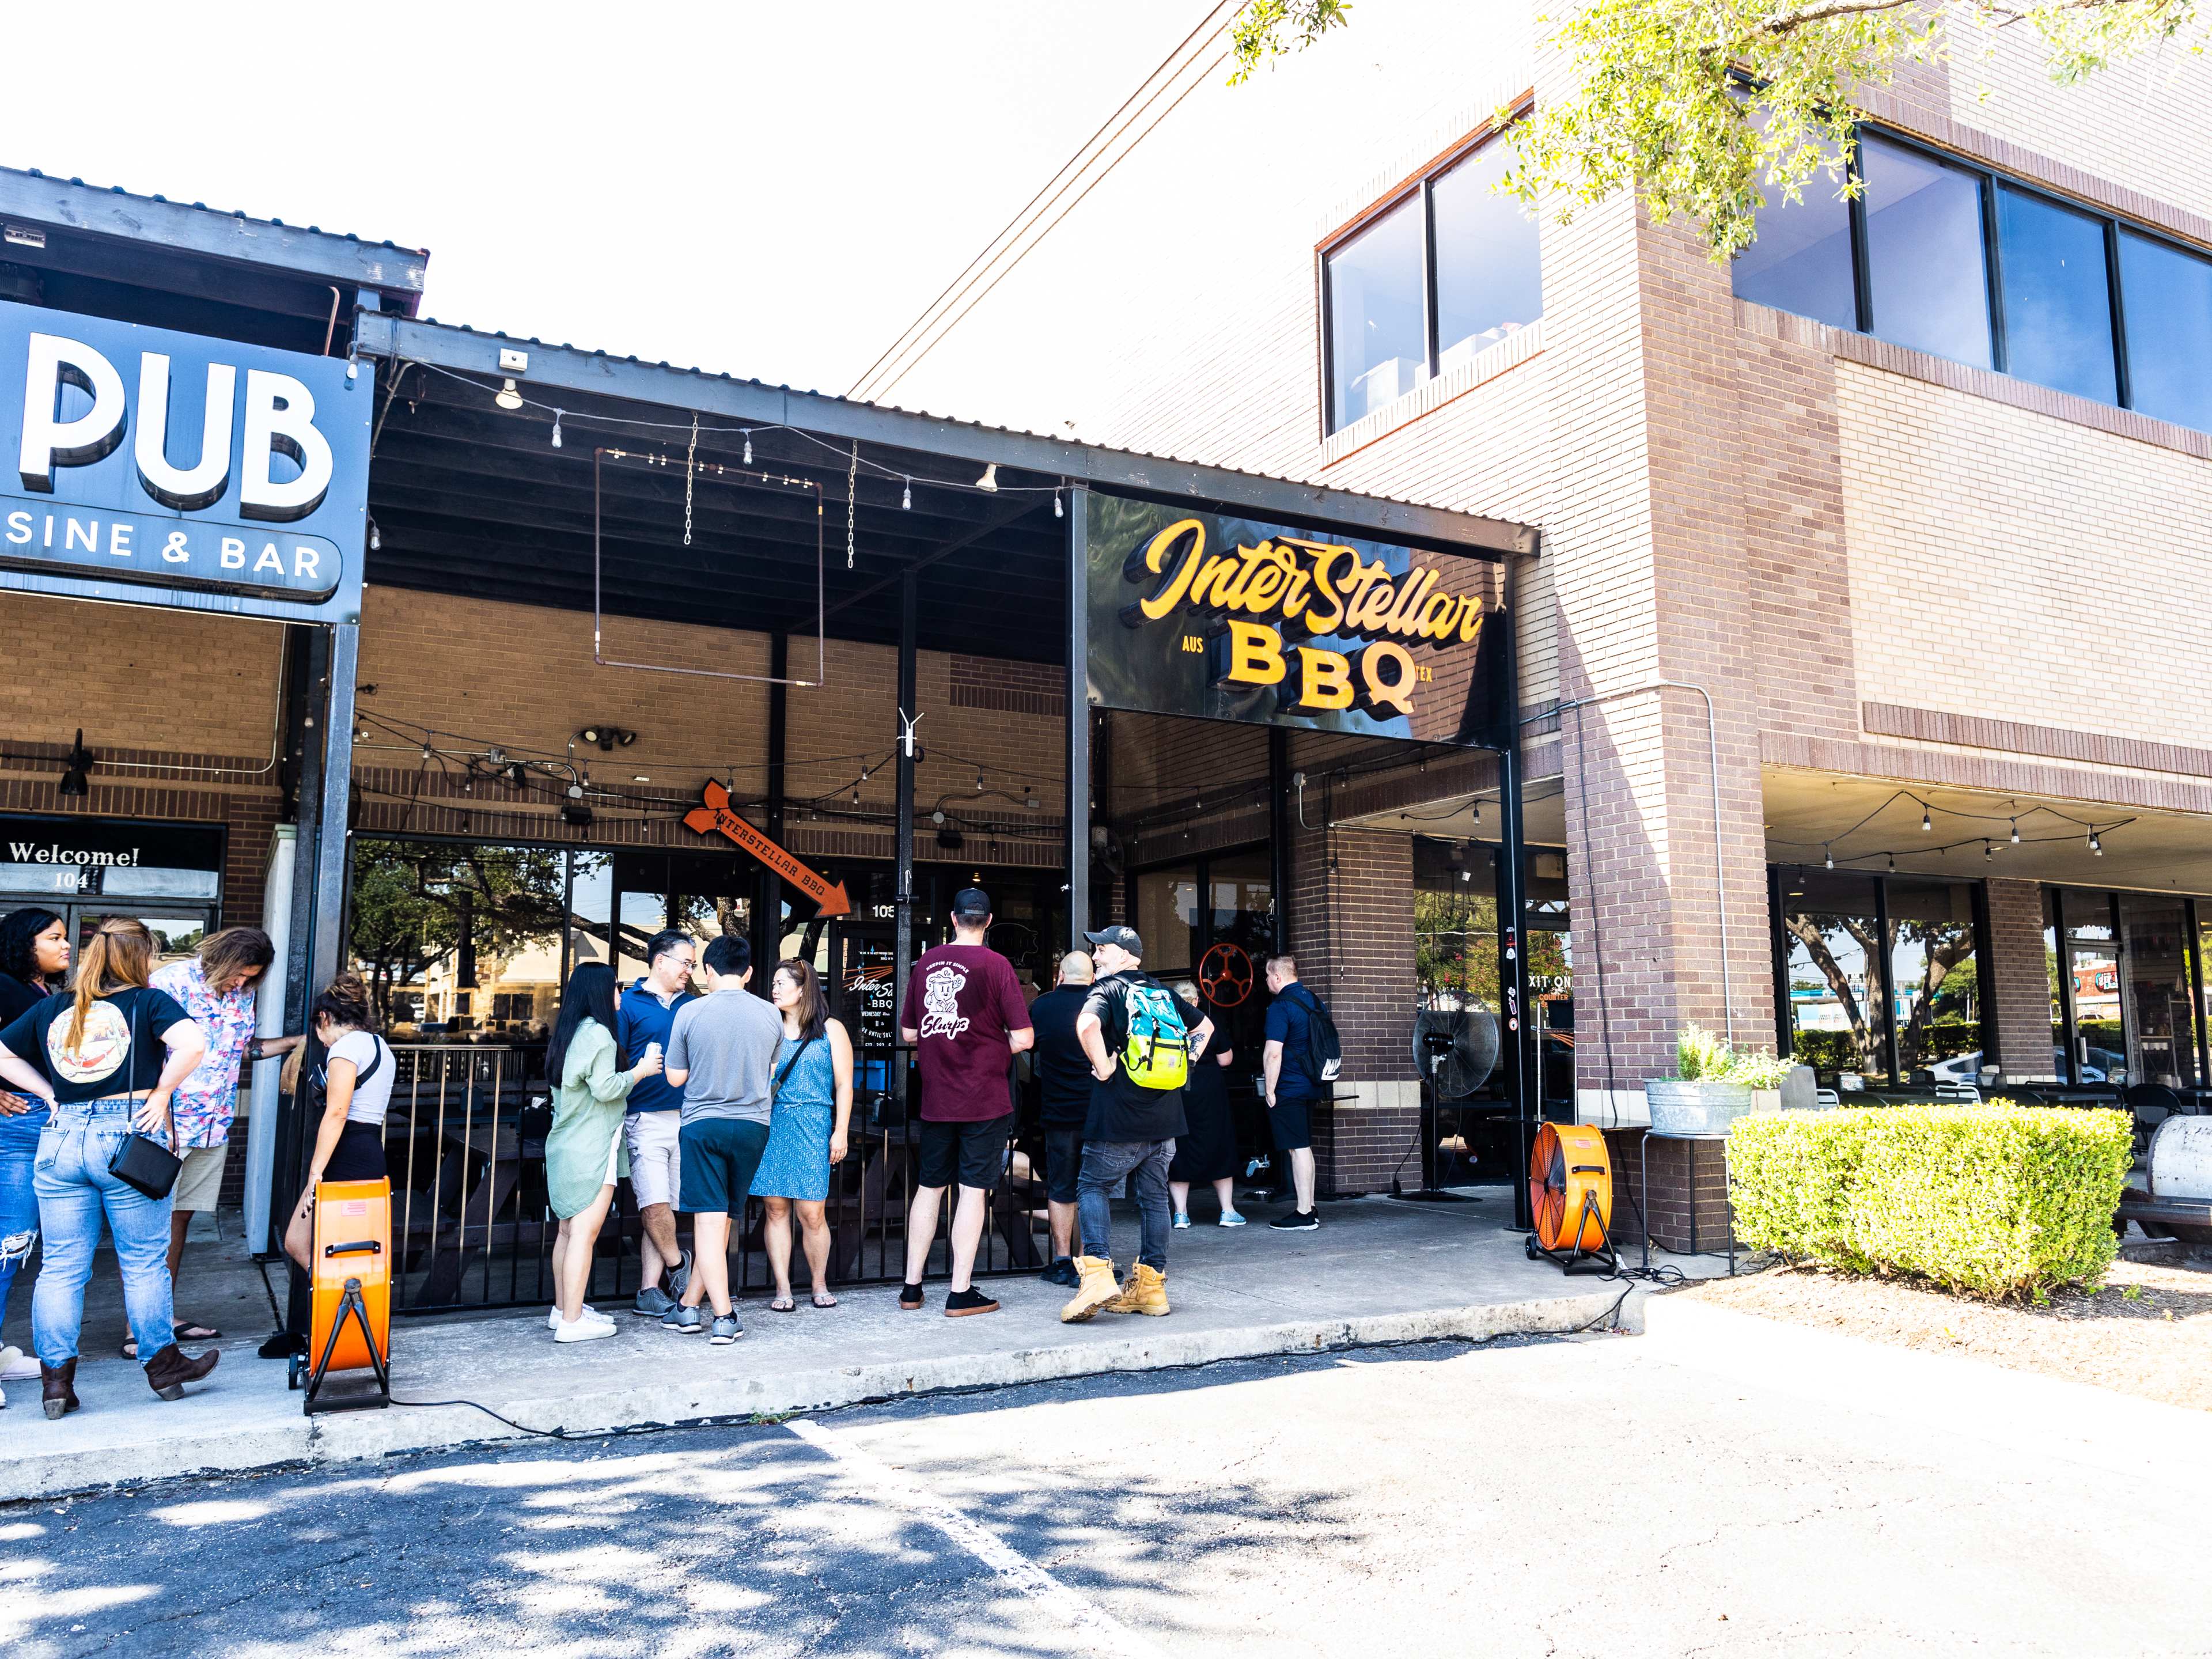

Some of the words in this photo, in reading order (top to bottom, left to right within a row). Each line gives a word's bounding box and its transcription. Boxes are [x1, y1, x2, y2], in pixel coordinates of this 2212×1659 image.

[19, 332, 334, 513] PUB
[6, 511, 133, 557] SINE
[162, 531, 190, 563] &
[220, 537, 320, 578] BAR
[1182, 635, 1204, 654] AUS
[1227, 619, 1415, 714] BBQ
[9, 842, 139, 867] Welcome!
[714, 810, 798, 877] INTERSTELLAR
[801, 874, 825, 896] BBQ
[55, 872, 89, 889] 104
[872, 904, 895, 918] 105
[868, 1030, 881, 1039] UNTIL
[922, 1015, 967, 1037] Slurps
